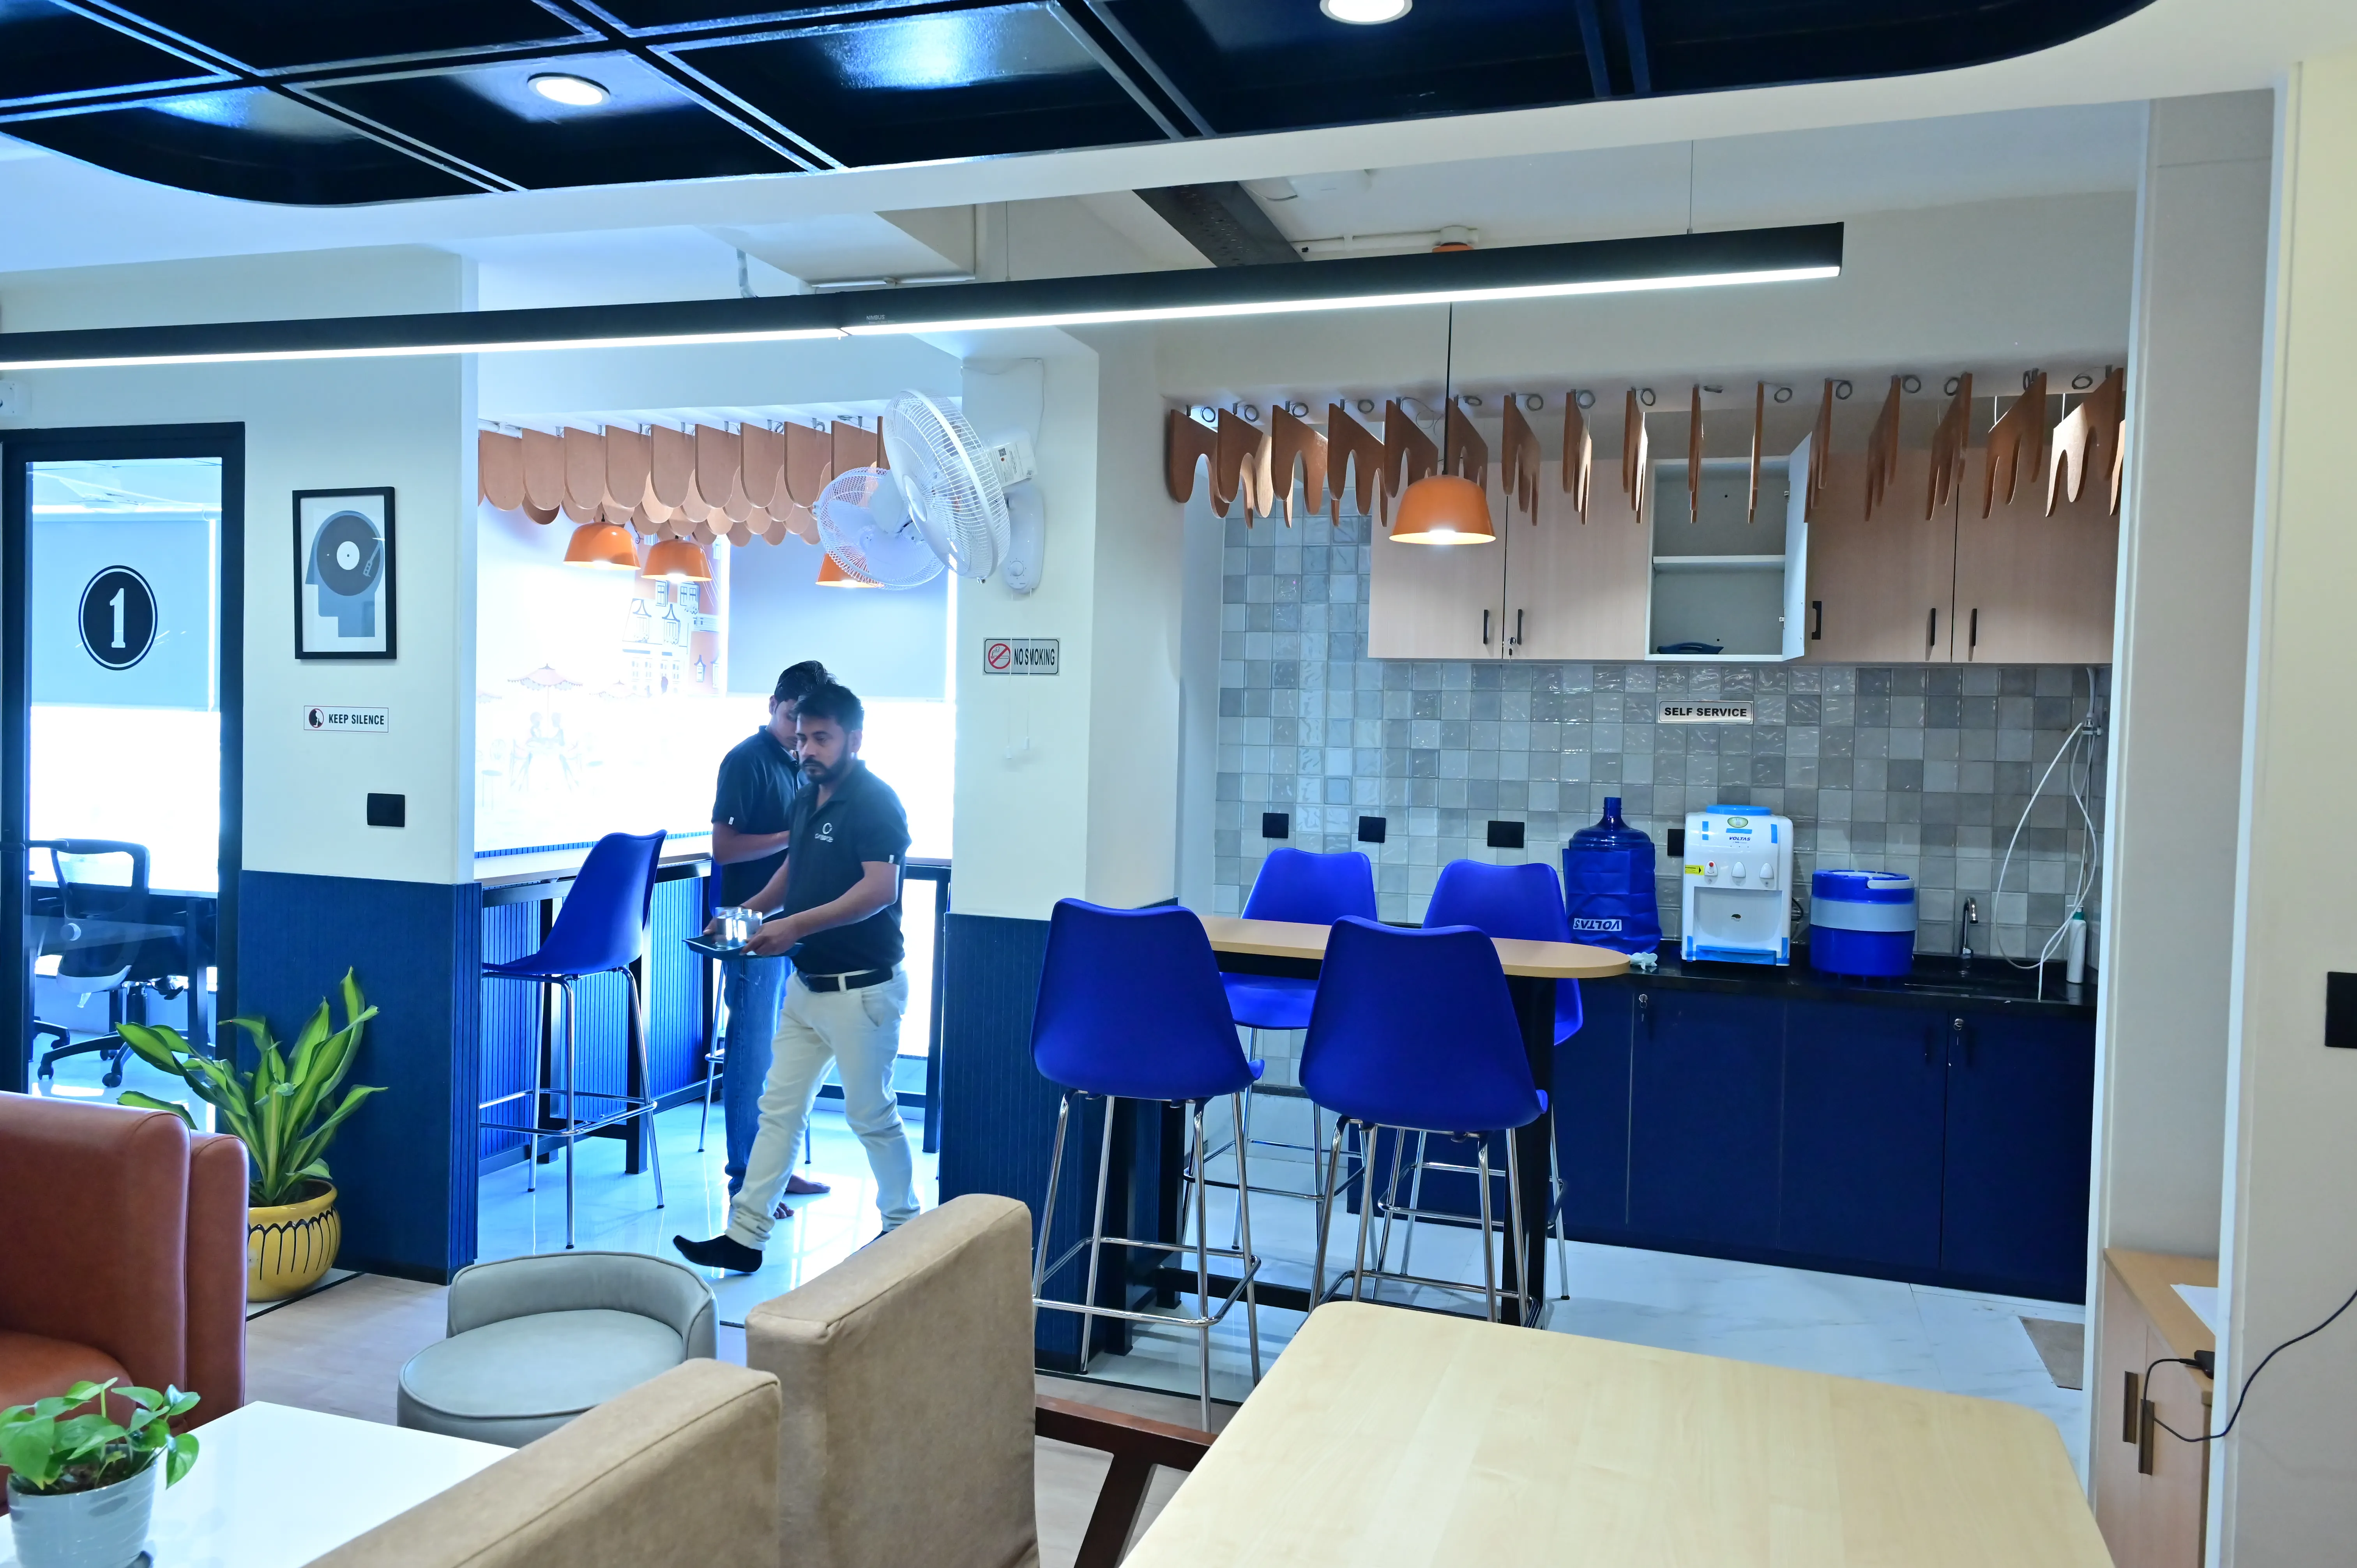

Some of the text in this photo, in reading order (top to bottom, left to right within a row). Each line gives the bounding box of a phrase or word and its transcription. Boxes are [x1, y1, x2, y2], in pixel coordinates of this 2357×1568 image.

[110, 588, 126, 648] 1
[1014, 648, 1055, 666] NO SMOKING
[1664, 707, 1747, 717] SELF SERVICE
[329, 714, 384, 725] KEEP SILENCE
[1574, 920, 1620, 930] VOLTAS
